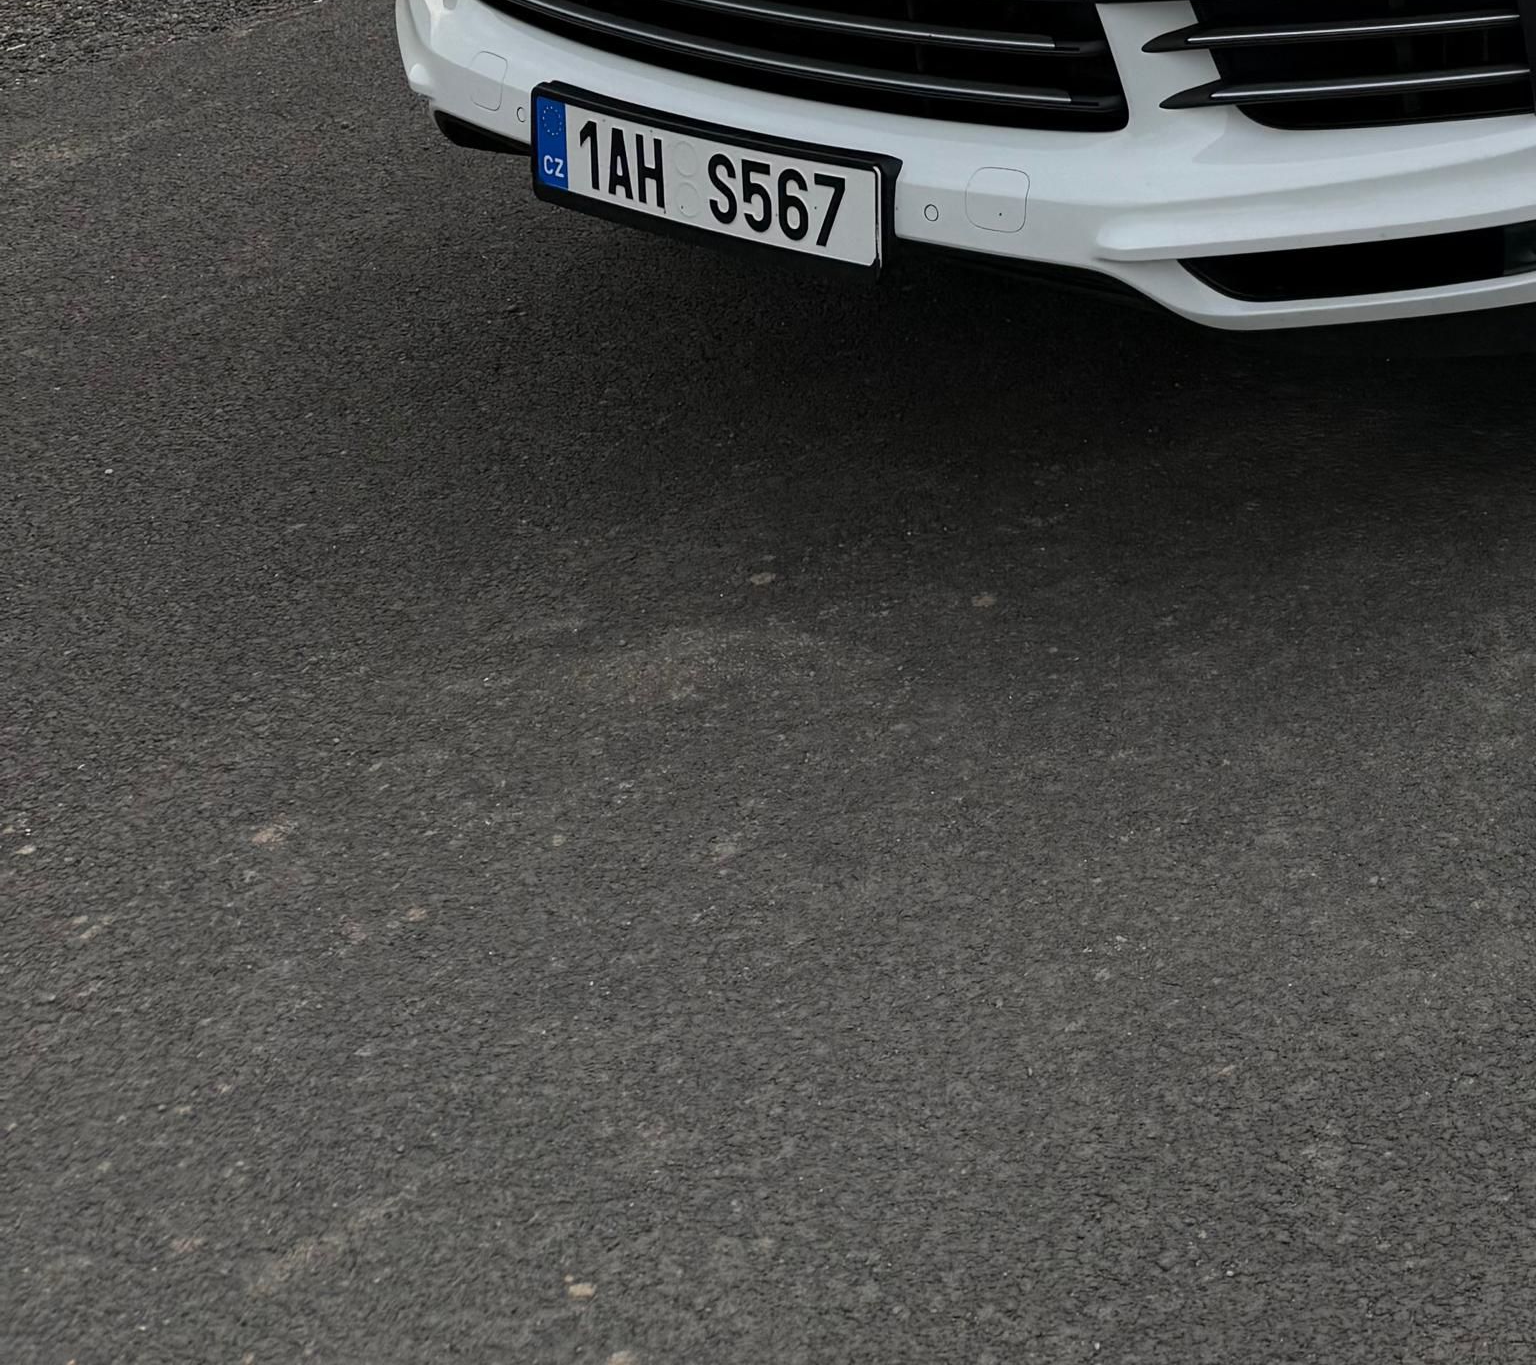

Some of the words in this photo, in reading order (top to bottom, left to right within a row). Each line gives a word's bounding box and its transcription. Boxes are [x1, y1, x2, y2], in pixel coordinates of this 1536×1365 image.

[544, 155, 564, 178] CZ
[580, 121, 665, 208] 1AH
[708, 153, 845, 247] S567
